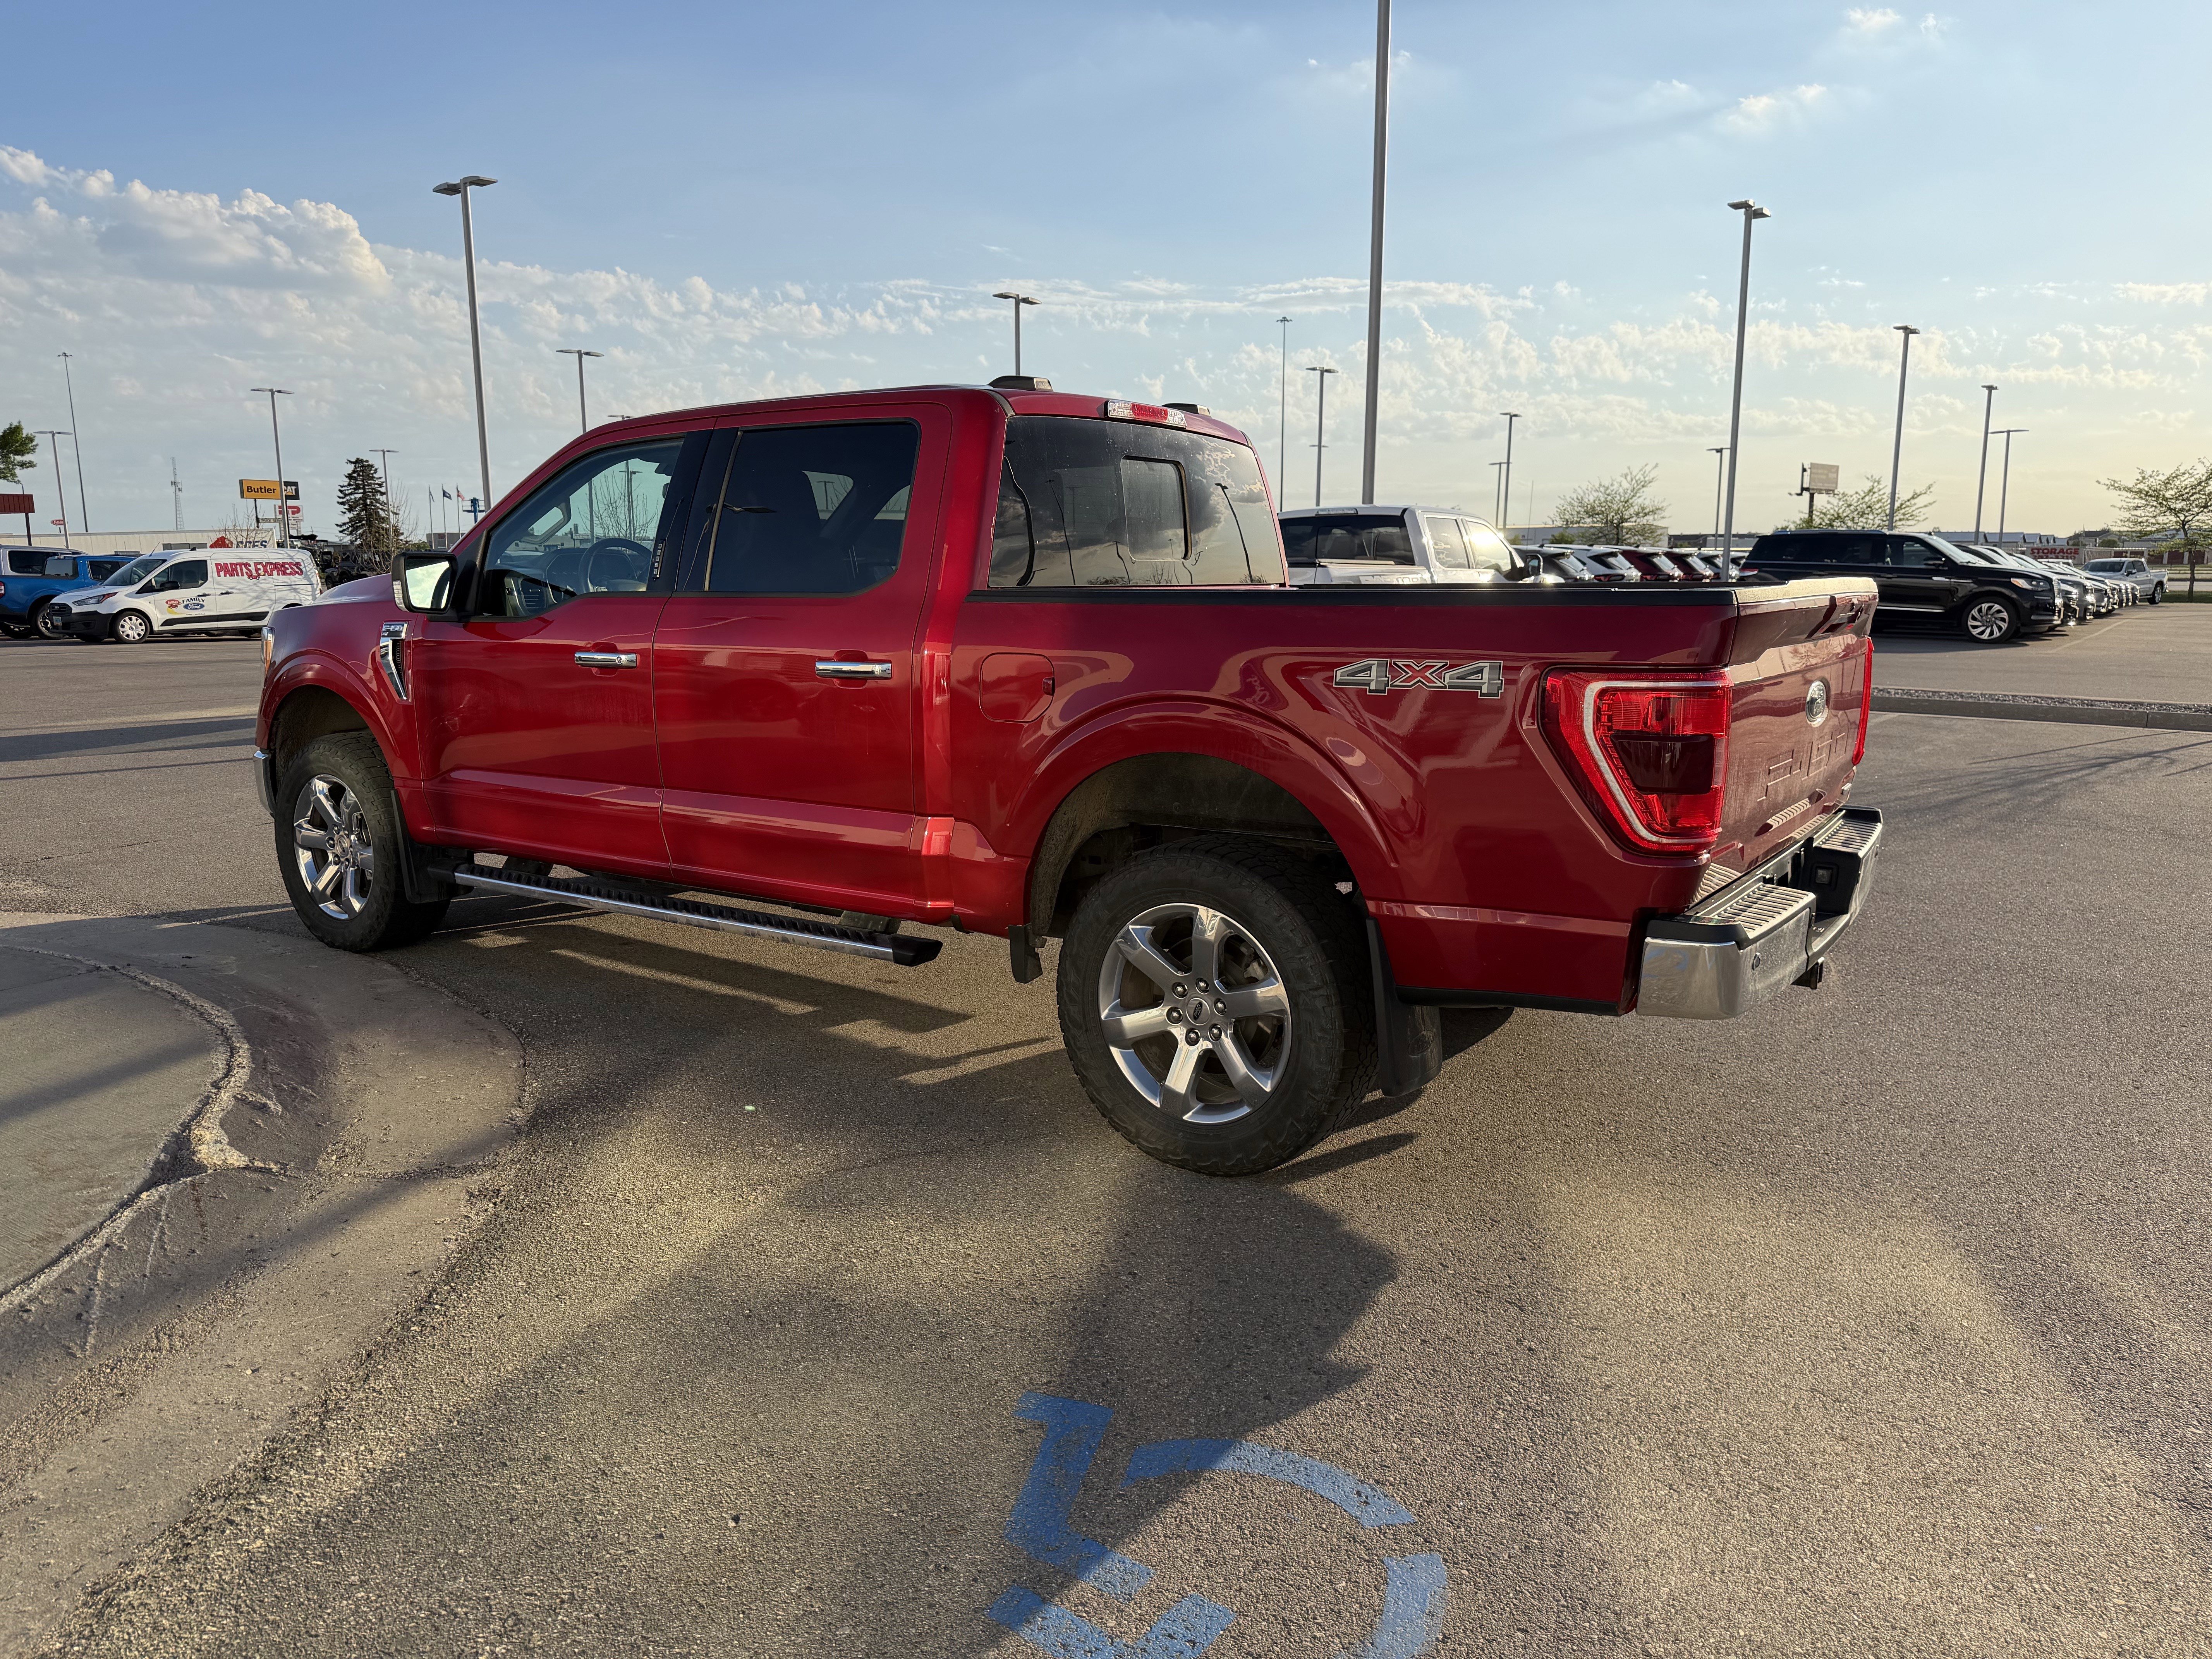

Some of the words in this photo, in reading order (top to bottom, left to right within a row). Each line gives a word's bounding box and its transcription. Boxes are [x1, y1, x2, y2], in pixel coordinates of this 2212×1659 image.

[247, 486, 276, 494] Butler
[215, 562, 252, 577] PARTS
[254, 562, 303, 576] EXPRESS
[1333, 658, 1504, 698] 4X4
